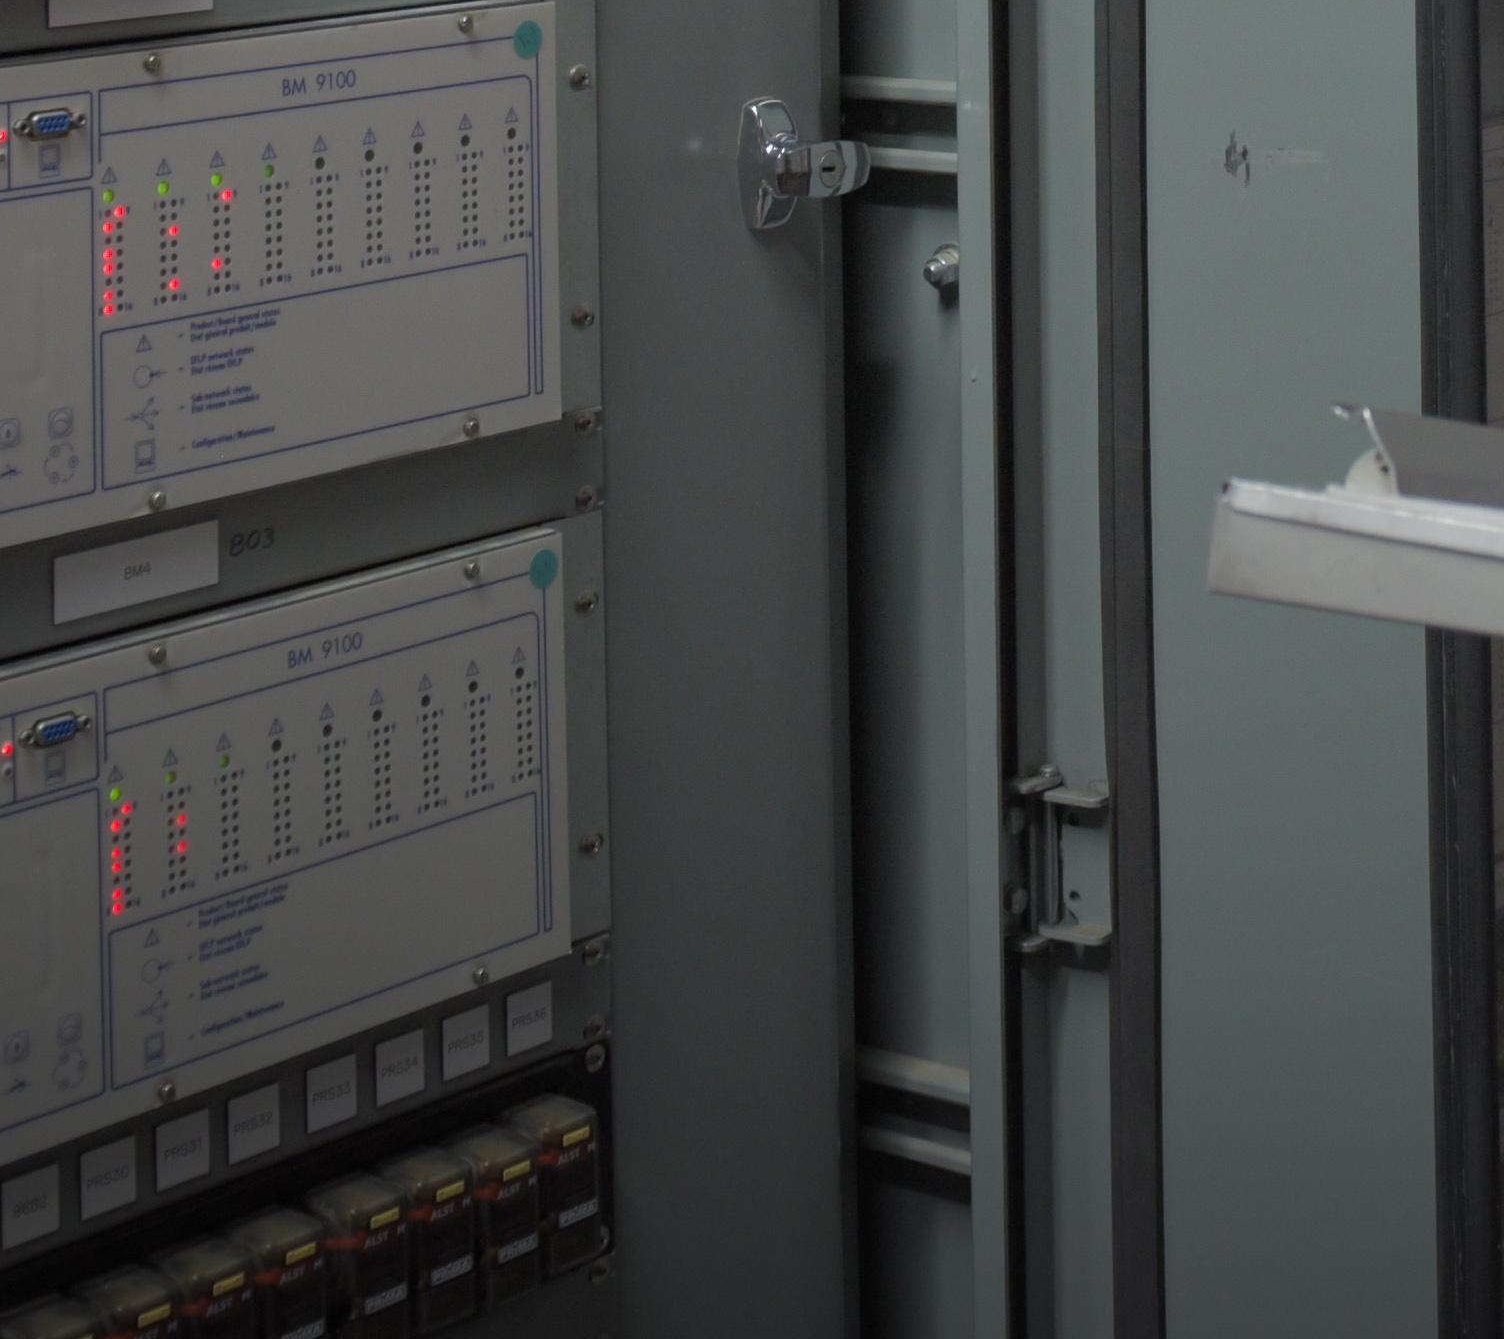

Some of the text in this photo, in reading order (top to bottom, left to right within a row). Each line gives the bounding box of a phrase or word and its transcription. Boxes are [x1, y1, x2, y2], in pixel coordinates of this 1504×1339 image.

[280, 69, 358, 97] BM 9100
[227, 525, 278, 554] 803
[122, 561, 153, 582] BM4
[285, 630, 364, 670] BM 9100
[510, 1007, 549, 1033] PRS36
[446, 1028, 486, 1056] PRS35
[379, 1054, 420, 1081] PRS34
[311, 1079, 353, 1108] PRS33
[232, 1109, 275, 1138] PRS32
[162, 1134, 205, 1163] PRS31
[556, 1140, 597, 1168] ALSTM
[85, 1163, 131, 1193] PRS30
[497, 1174, 538, 1201] ALSTM
[430, 1195, 473, 1222] ALSTM
[363, 1221, 407, 1251] ALSTM
